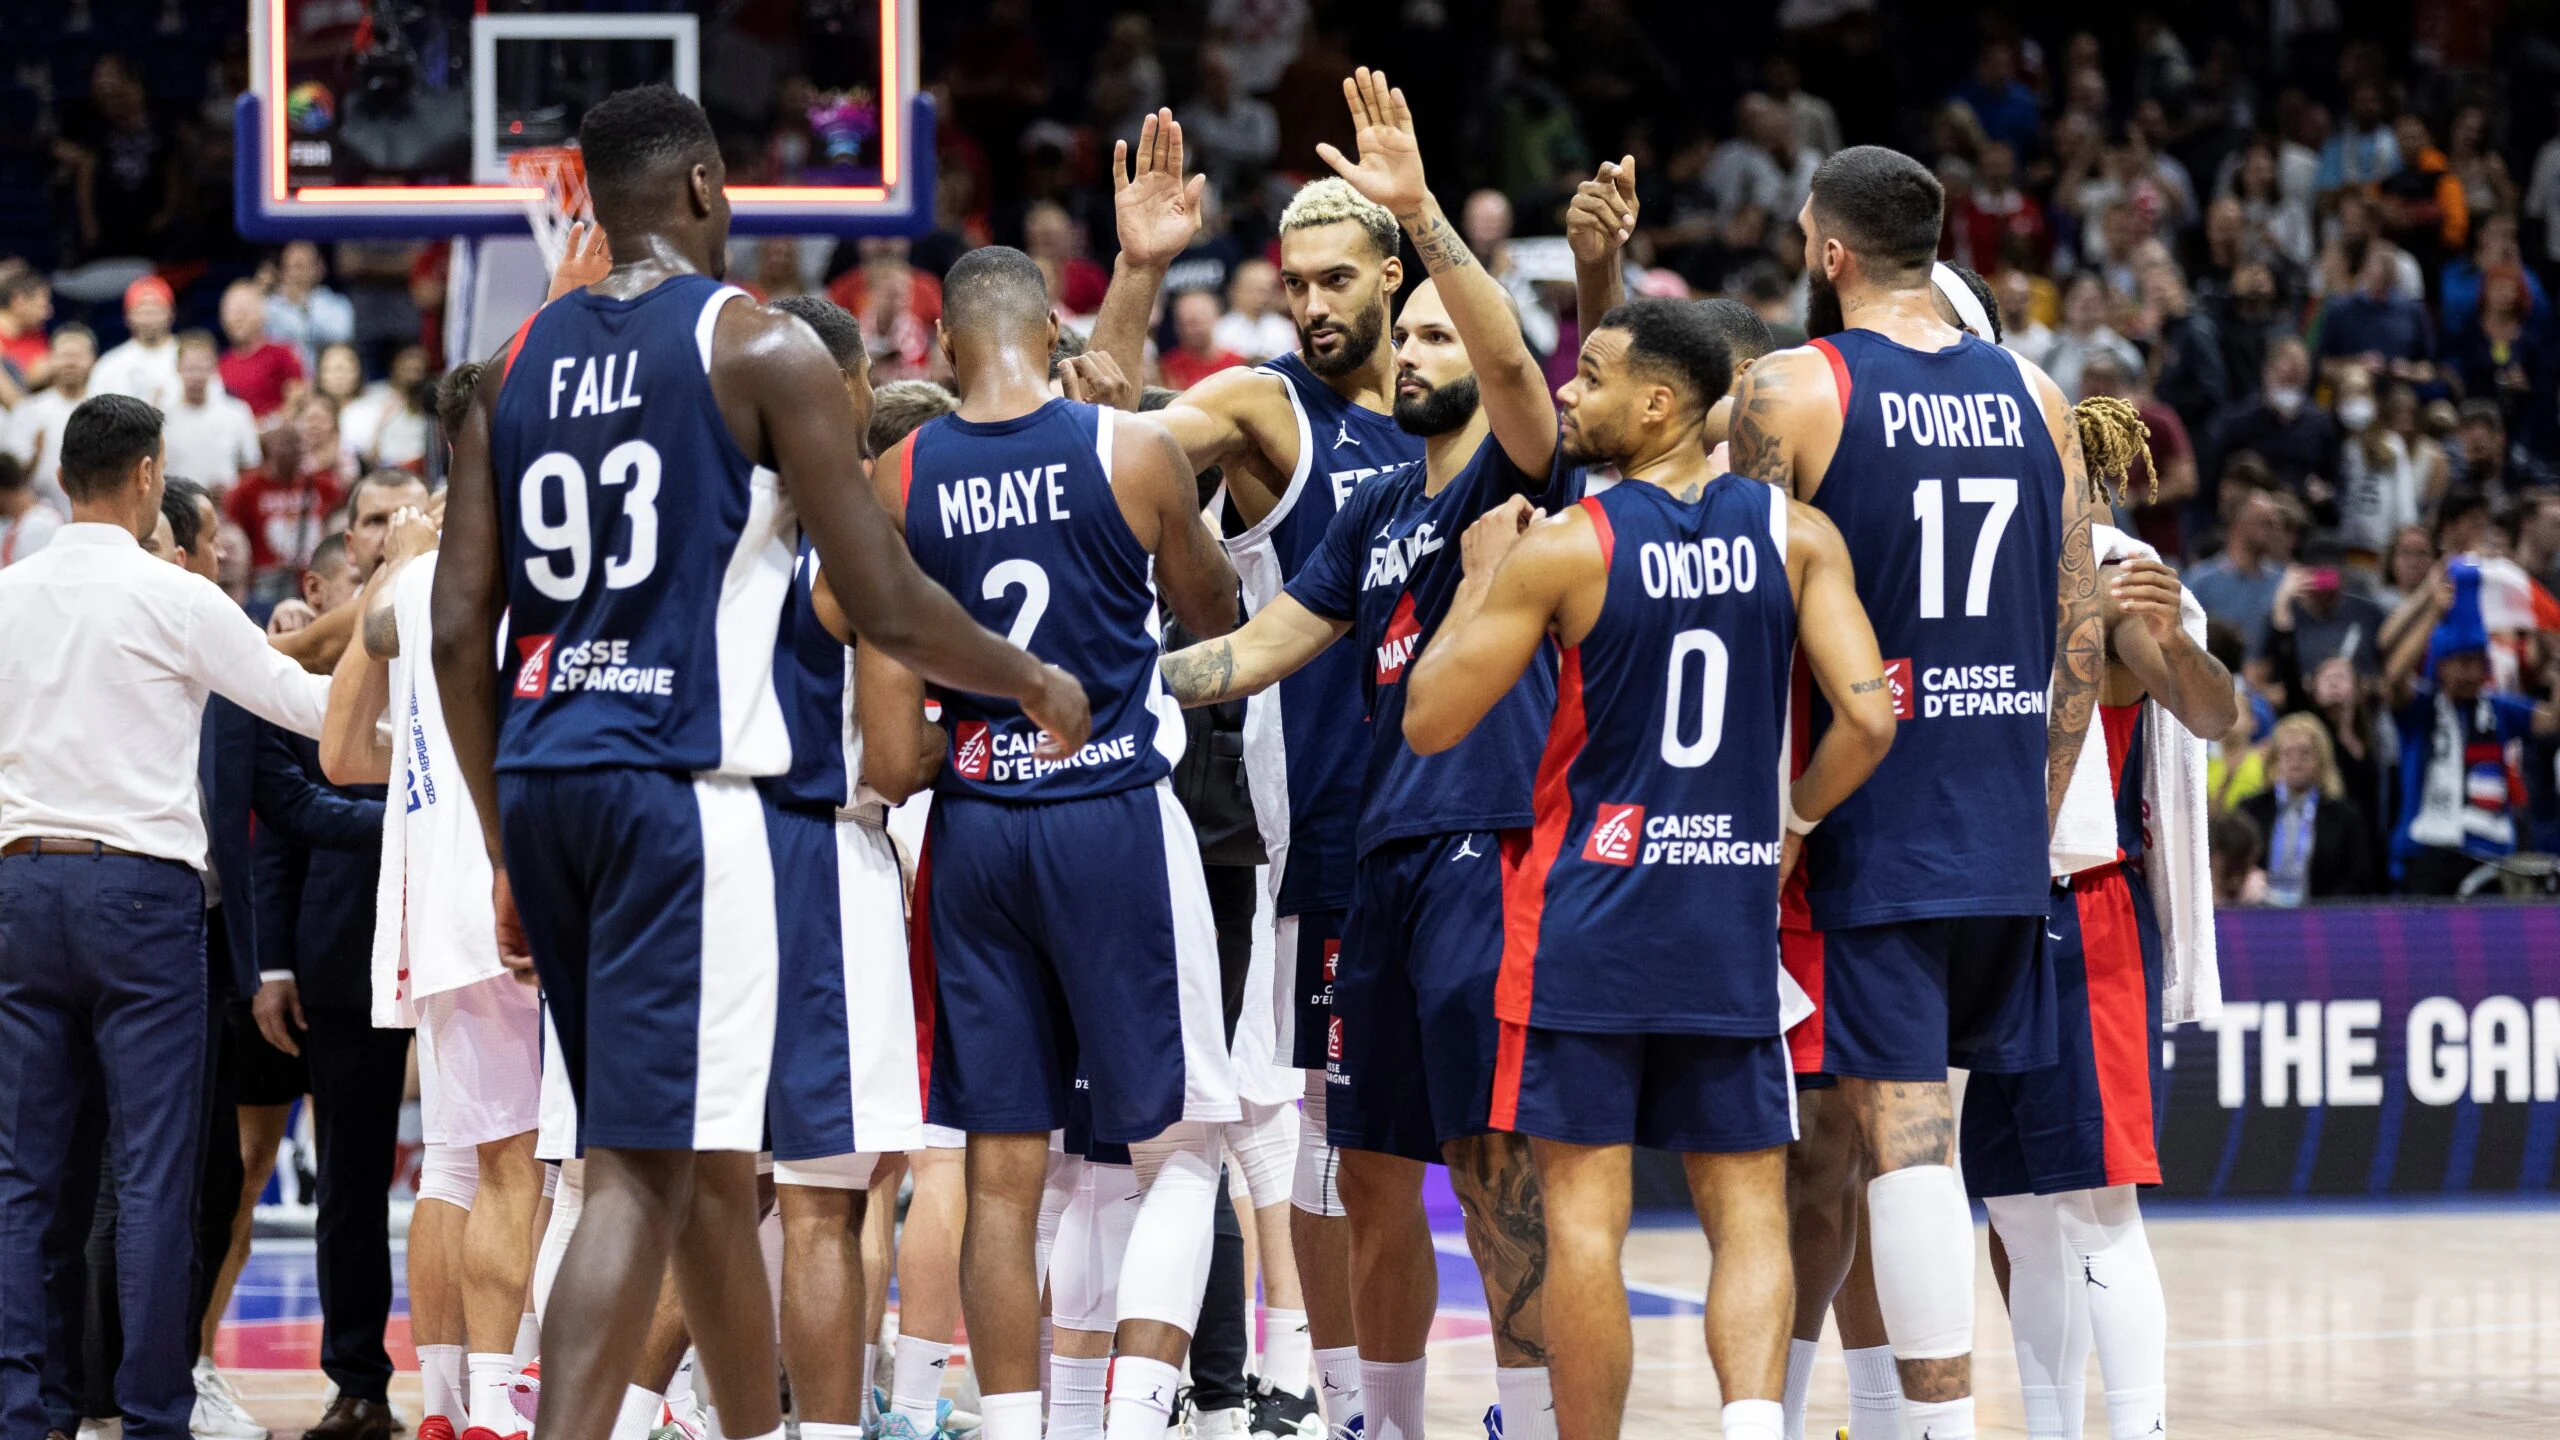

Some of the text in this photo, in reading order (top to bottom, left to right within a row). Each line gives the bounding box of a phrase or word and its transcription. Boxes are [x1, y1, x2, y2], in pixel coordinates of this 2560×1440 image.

[550, 350, 642, 420] FALL
[1879, 392, 2025, 447] POIRIER
[519, 439, 662, 601] 93
[937, 463, 1070, 539] MBAYE
[1640, 535, 1758, 599] OKOBO
[1913, 477, 2019, 618] 17
[982, 558, 1050, 652] 2
[1660, 628, 1729, 768] 0
[1922, 665, 2017, 692] CAISSE
[1924, 690, 2046, 718] D'EPARGN
[412, 724, 431, 773] REPUBLIC
[423, 773, 437, 805] CZECH
[1646, 814, 1733, 839] CAISSE
[2201, 999, 2384, 1108] THE
